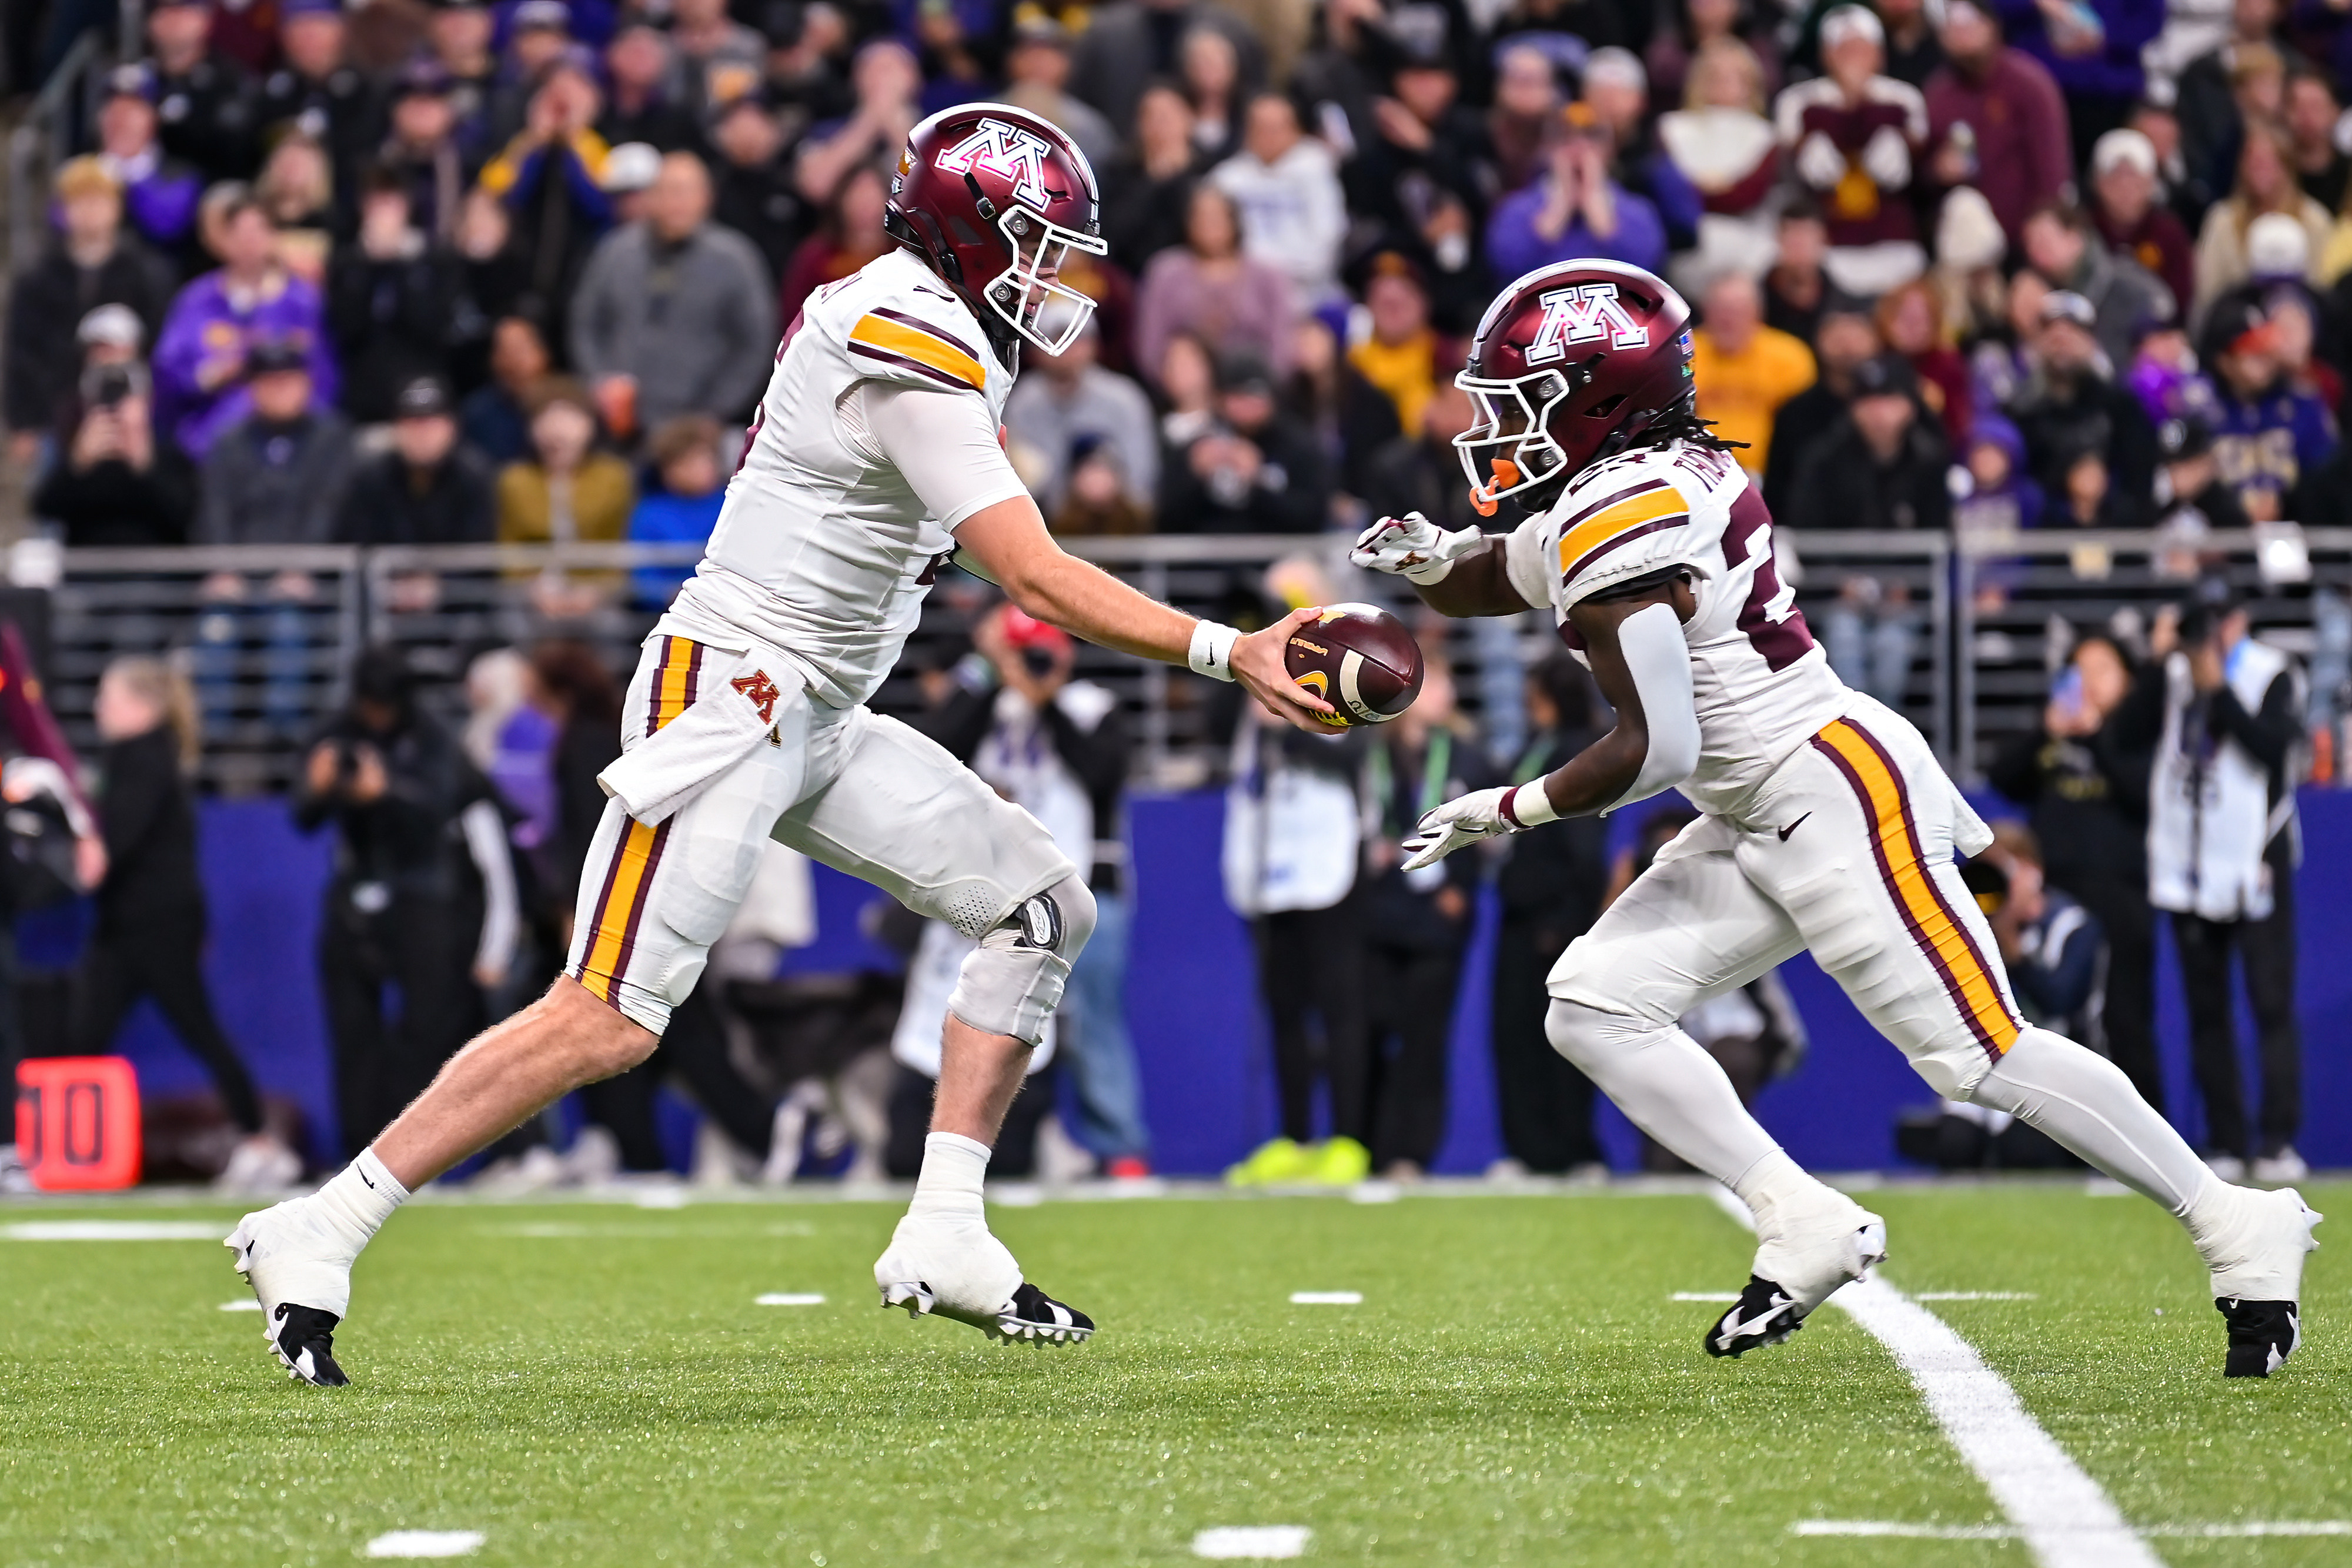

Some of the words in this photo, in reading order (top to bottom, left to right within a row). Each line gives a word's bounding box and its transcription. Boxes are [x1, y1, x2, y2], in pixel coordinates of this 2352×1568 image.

[934, 117, 1051, 213] M
[1525, 283, 1650, 366] M
[729, 668, 781, 726] M
